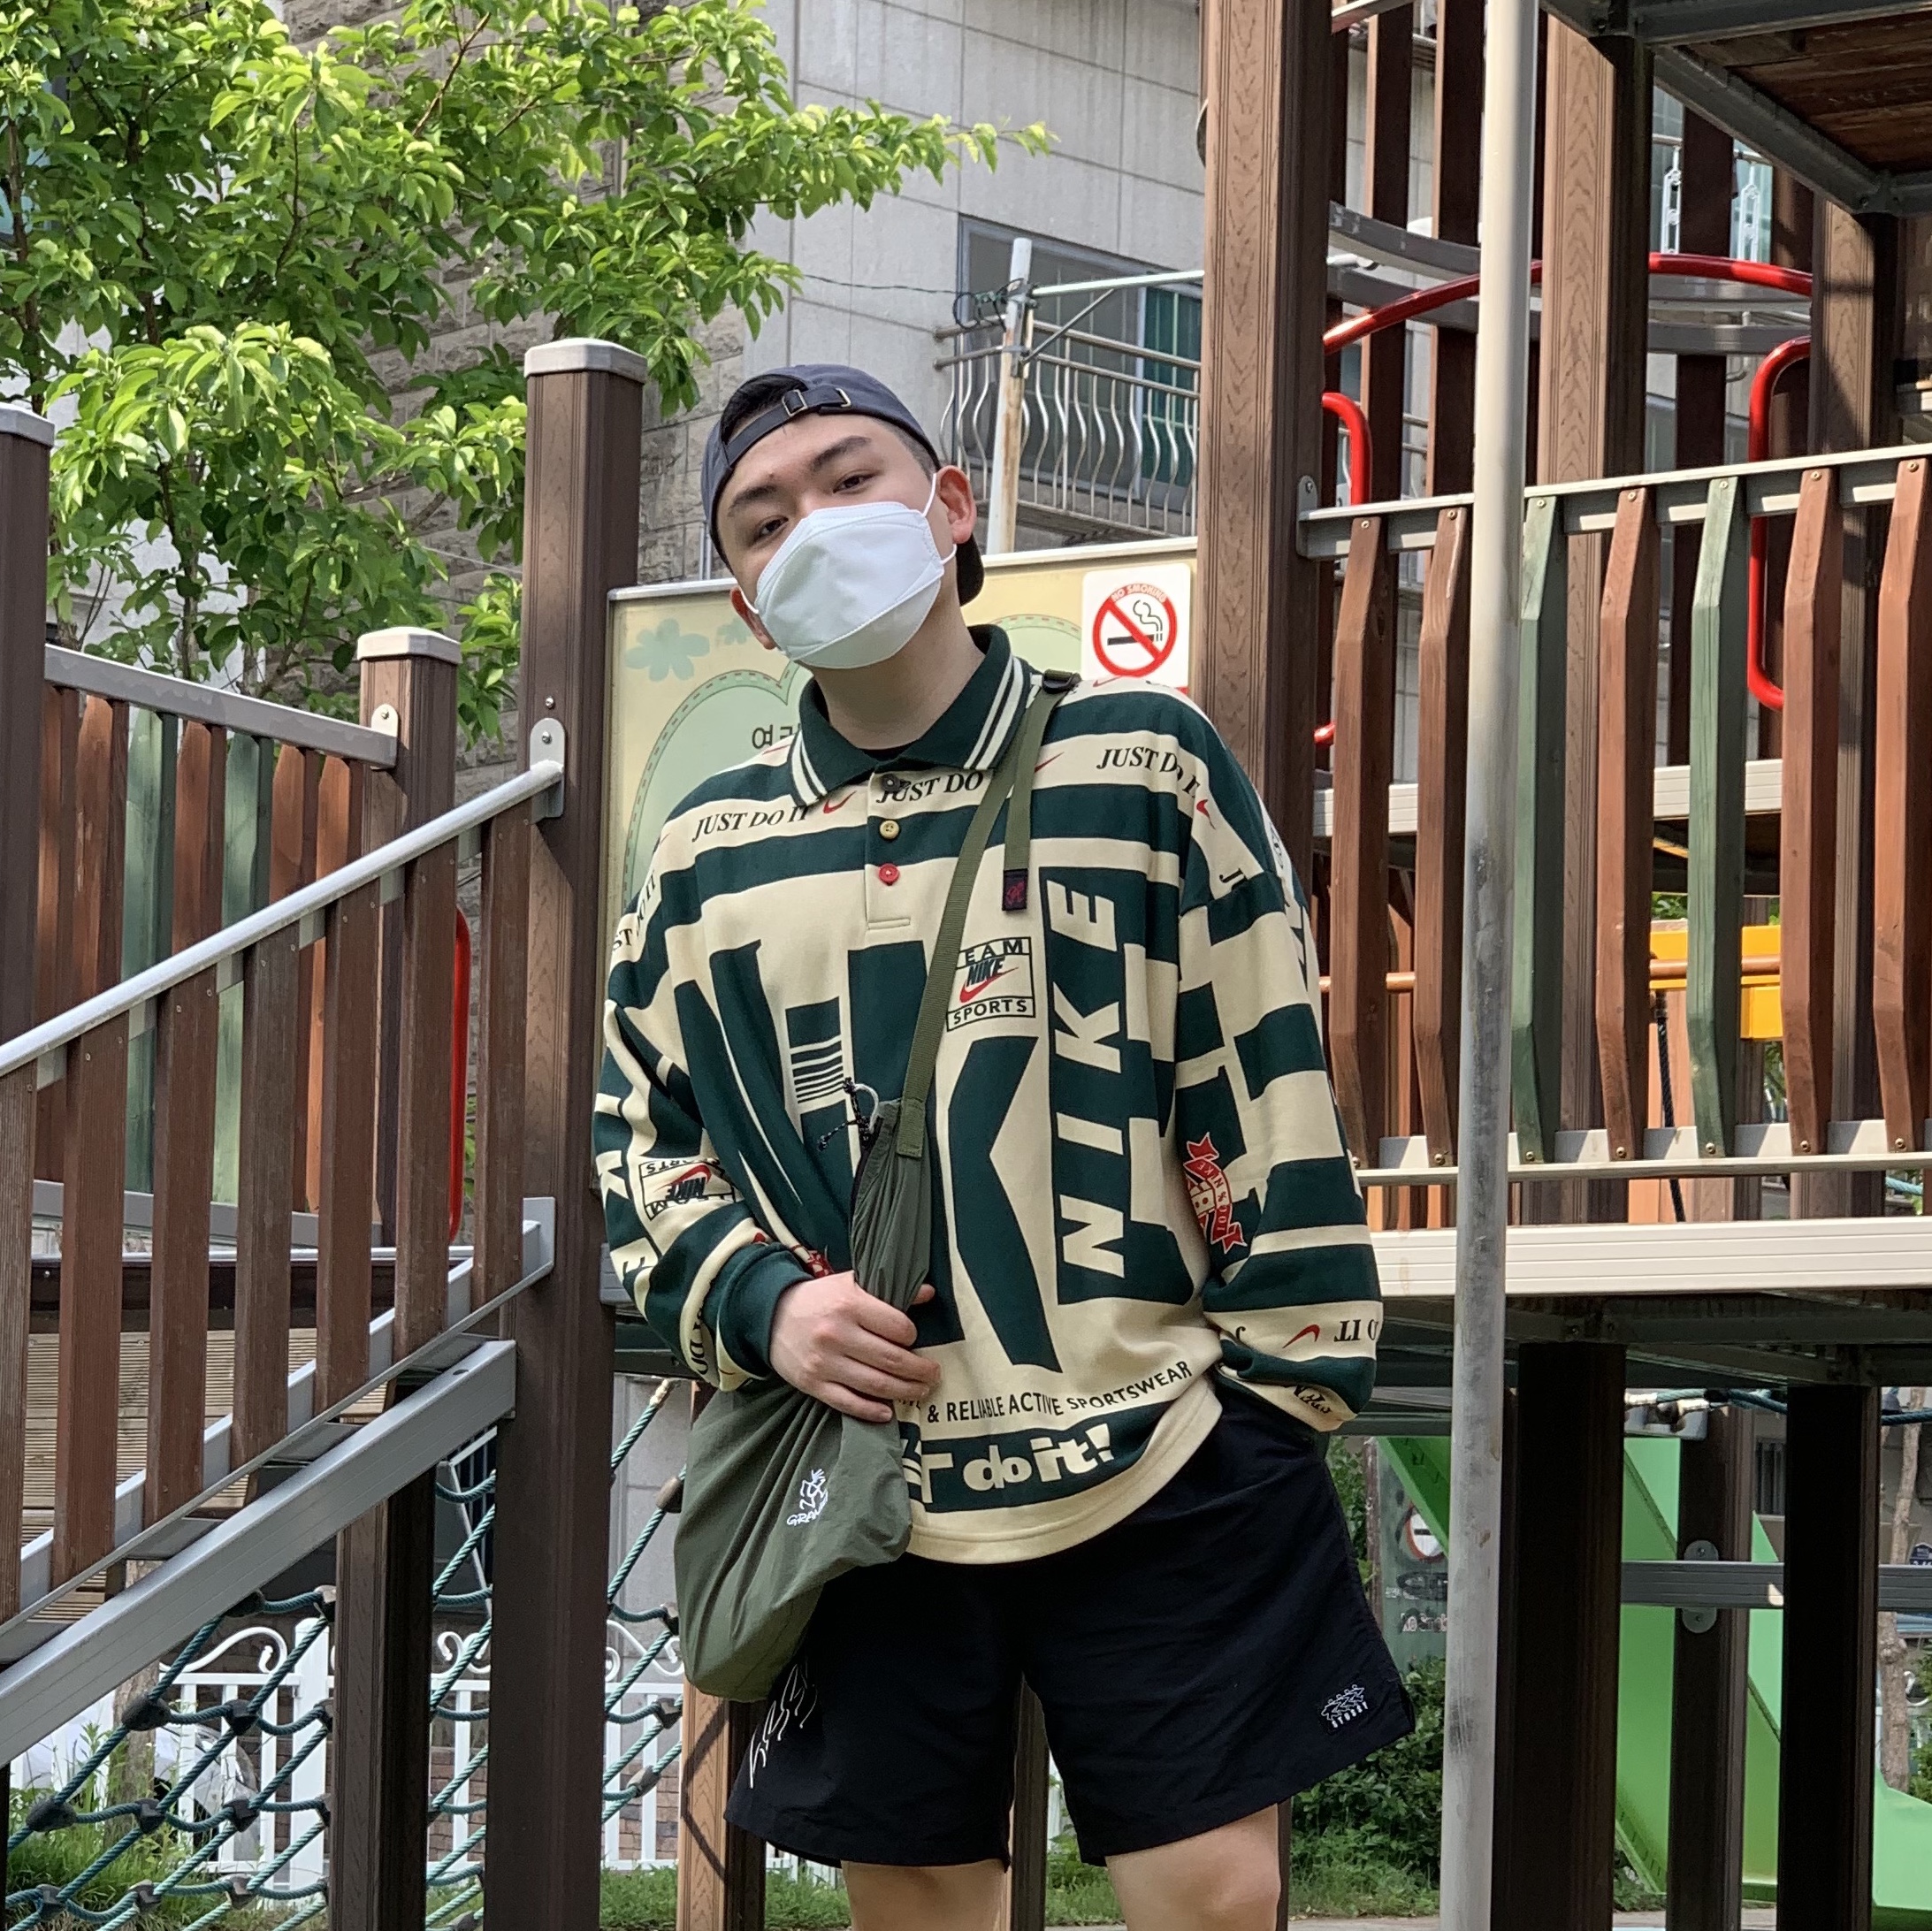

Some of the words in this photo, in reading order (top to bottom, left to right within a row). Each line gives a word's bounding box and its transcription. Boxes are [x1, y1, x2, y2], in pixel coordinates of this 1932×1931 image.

[1111, 589, 1126, 601] NO
[1127, 584, 1168, 602] SMOKING
[1096, 746, 1159, 771] JUST
[943, 771, 984, 793] DO
[691, 812, 749, 843] JUST
[748, 809, 785, 828] DO
[965, 939, 1024, 966] EAM
[966, 955, 1006, 987] NIKE
[953, 999, 1027, 1025] SPORTS
[1046, 880, 1126, 1279] NIKE
[665, 1177, 706, 1200] NIKE
[1197, 1163, 1225, 1188] NIKE
[1333, 1318, 1362, 1342] IT
[927, 1404, 940, 1423] &
[946, 1395, 1006, 1422] RELIABLE
[1008, 1392, 1065, 1416] ACTIVE
[1066, 1360, 1194, 1412] SPORTSWEAR
[963, 1445, 1033, 1492] do
[1029, 1423, 1115, 1483] it!
